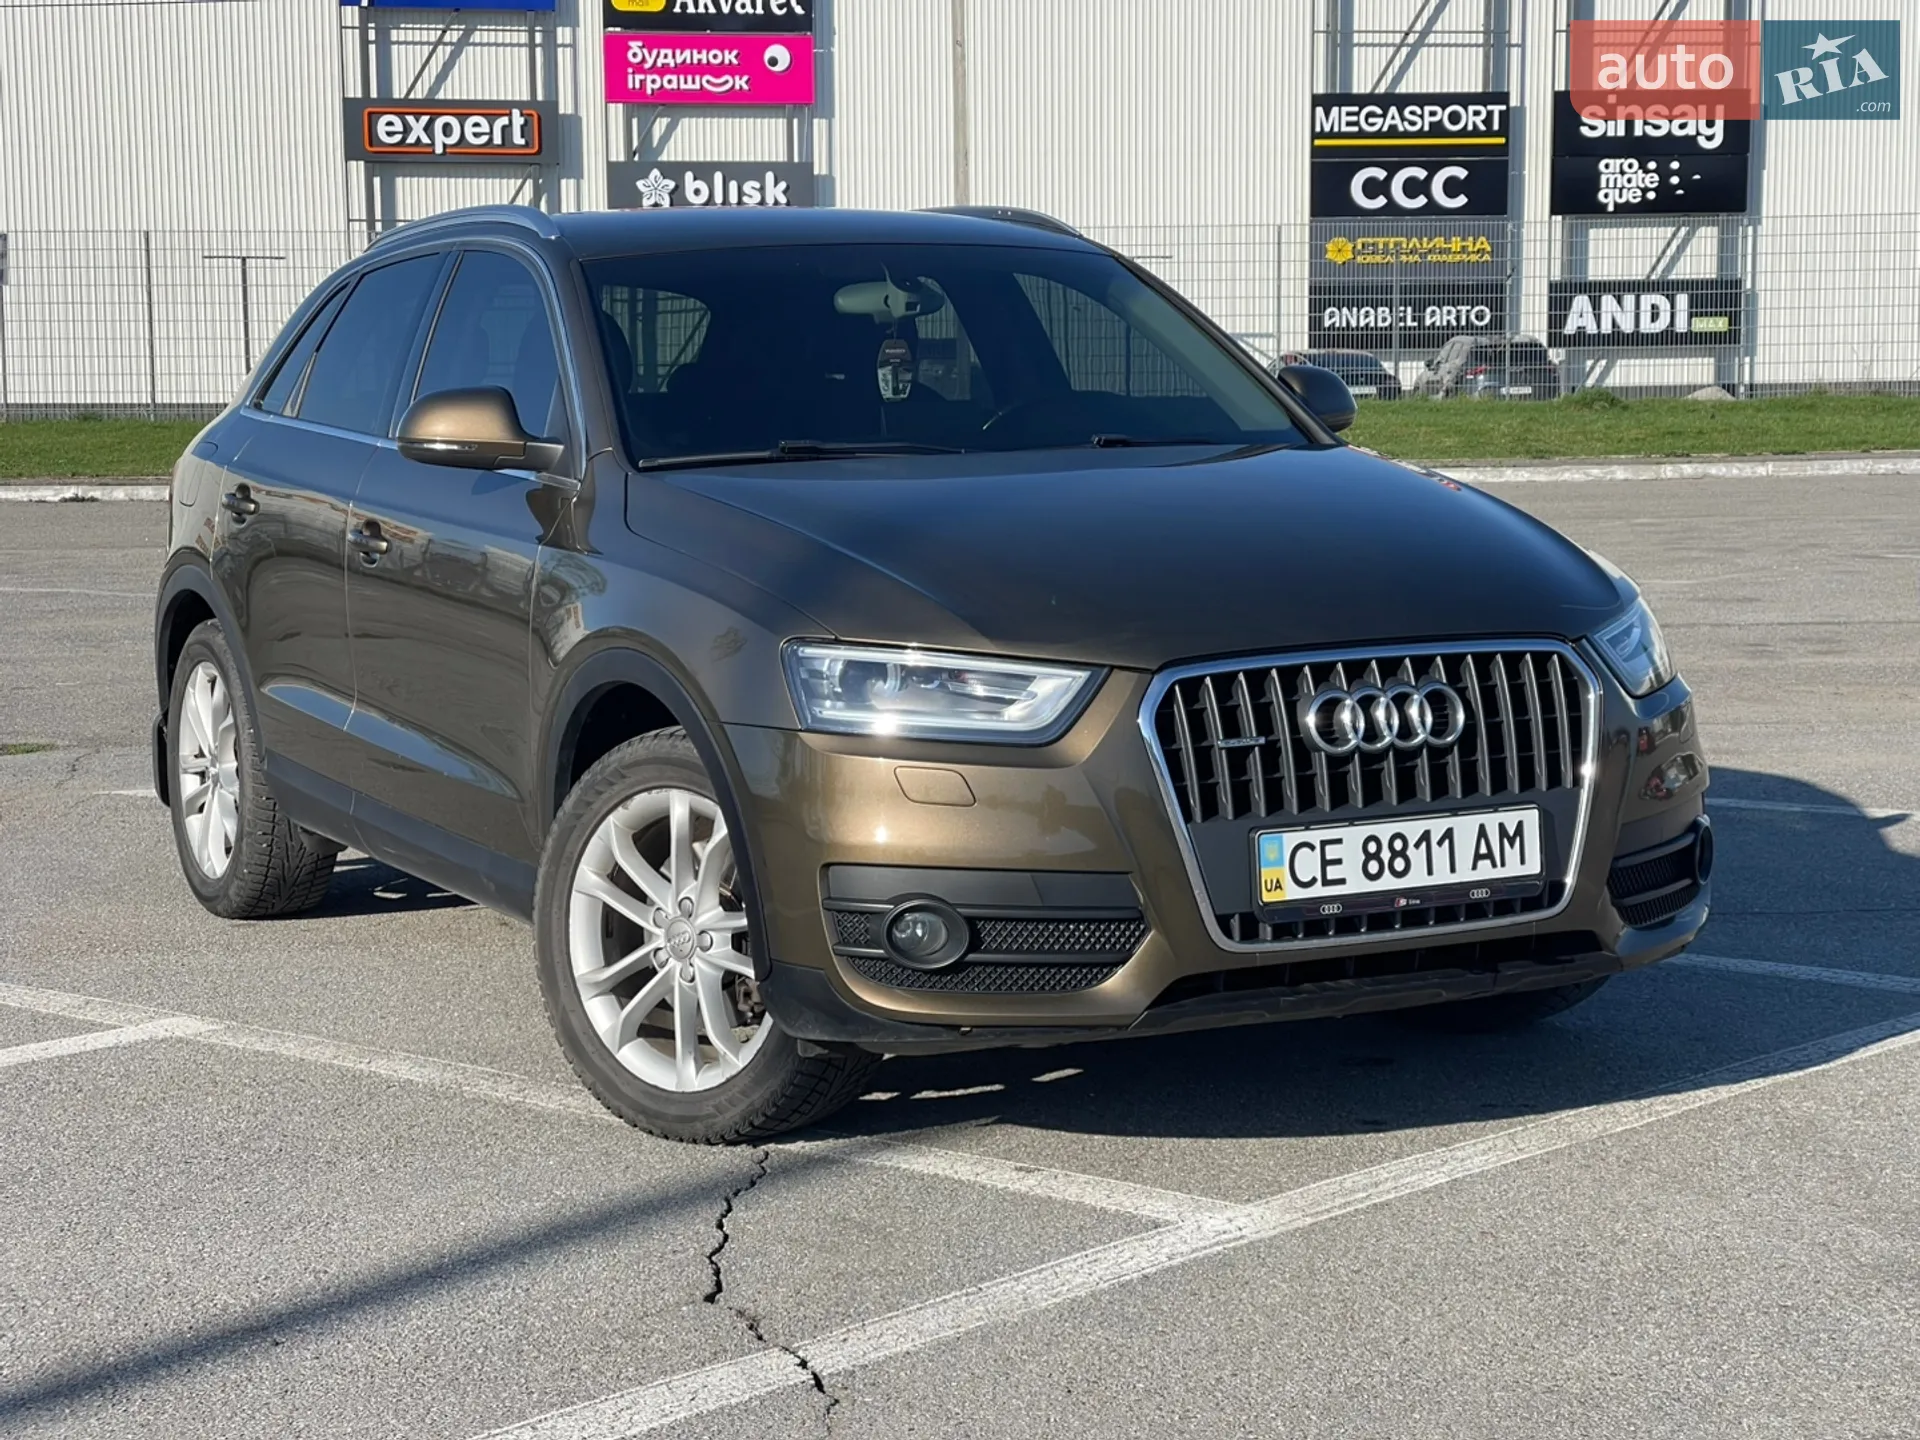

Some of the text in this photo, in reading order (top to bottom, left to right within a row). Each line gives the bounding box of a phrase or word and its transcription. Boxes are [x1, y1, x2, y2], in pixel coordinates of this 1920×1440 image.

[627, 41, 739, 69] будинок
[376, 108, 527, 155] expert
[1314, 104, 1506, 133] MEGASPORT
[1579, 94, 1725, 150] sinsay
[683, 170, 788, 206] blisk
[1350, 165, 1469, 209] CCC
[1598, 187, 1642, 212] que
[1425, 305, 1492, 326] ARTO
[1563, 293, 1688, 334] ANDI
[1288, 818, 1527, 888] CE 8811 AM
[1263, 878, 1284, 893] UA
